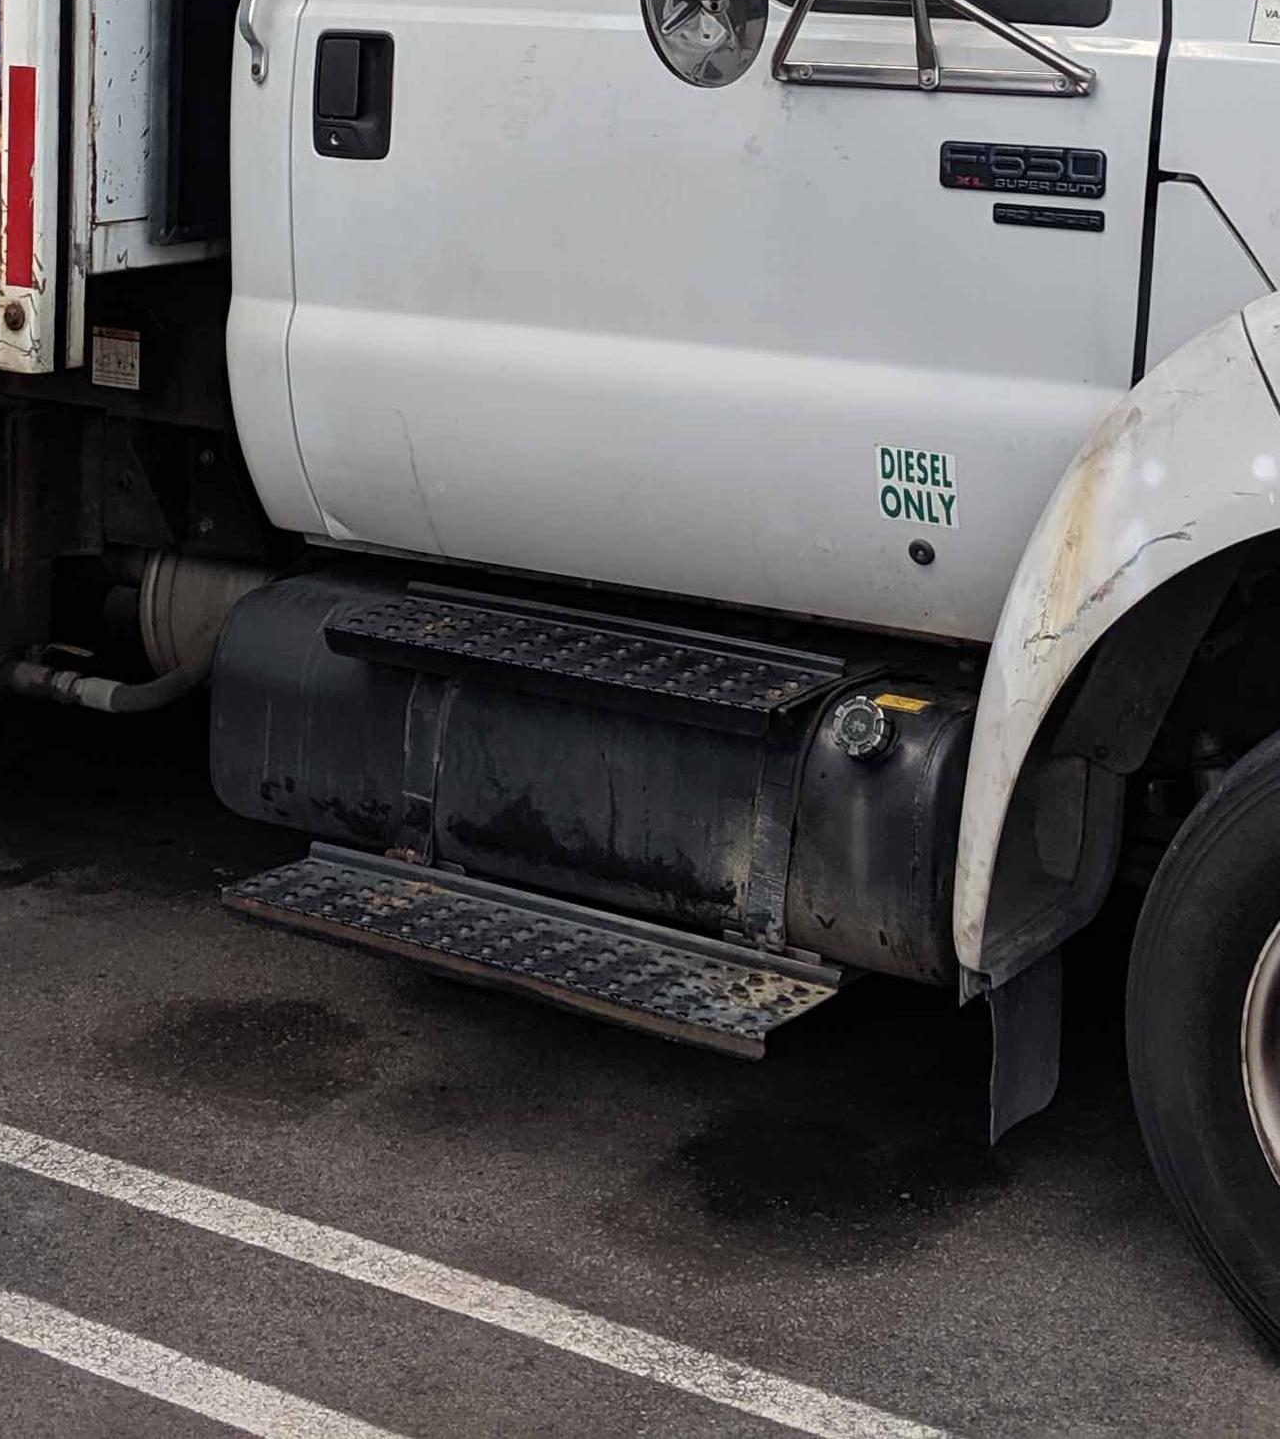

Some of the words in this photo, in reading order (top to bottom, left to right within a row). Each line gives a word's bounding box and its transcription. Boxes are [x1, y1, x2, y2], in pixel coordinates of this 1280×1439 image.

[994, 177, 1051, 192] SUPER
[1055, 182, 1103, 195] DUTY
[995, 207, 1029, 222] PRO
[880, 446, 953, 489] DIESEL
[880, 484, 956, 526] ONLY
